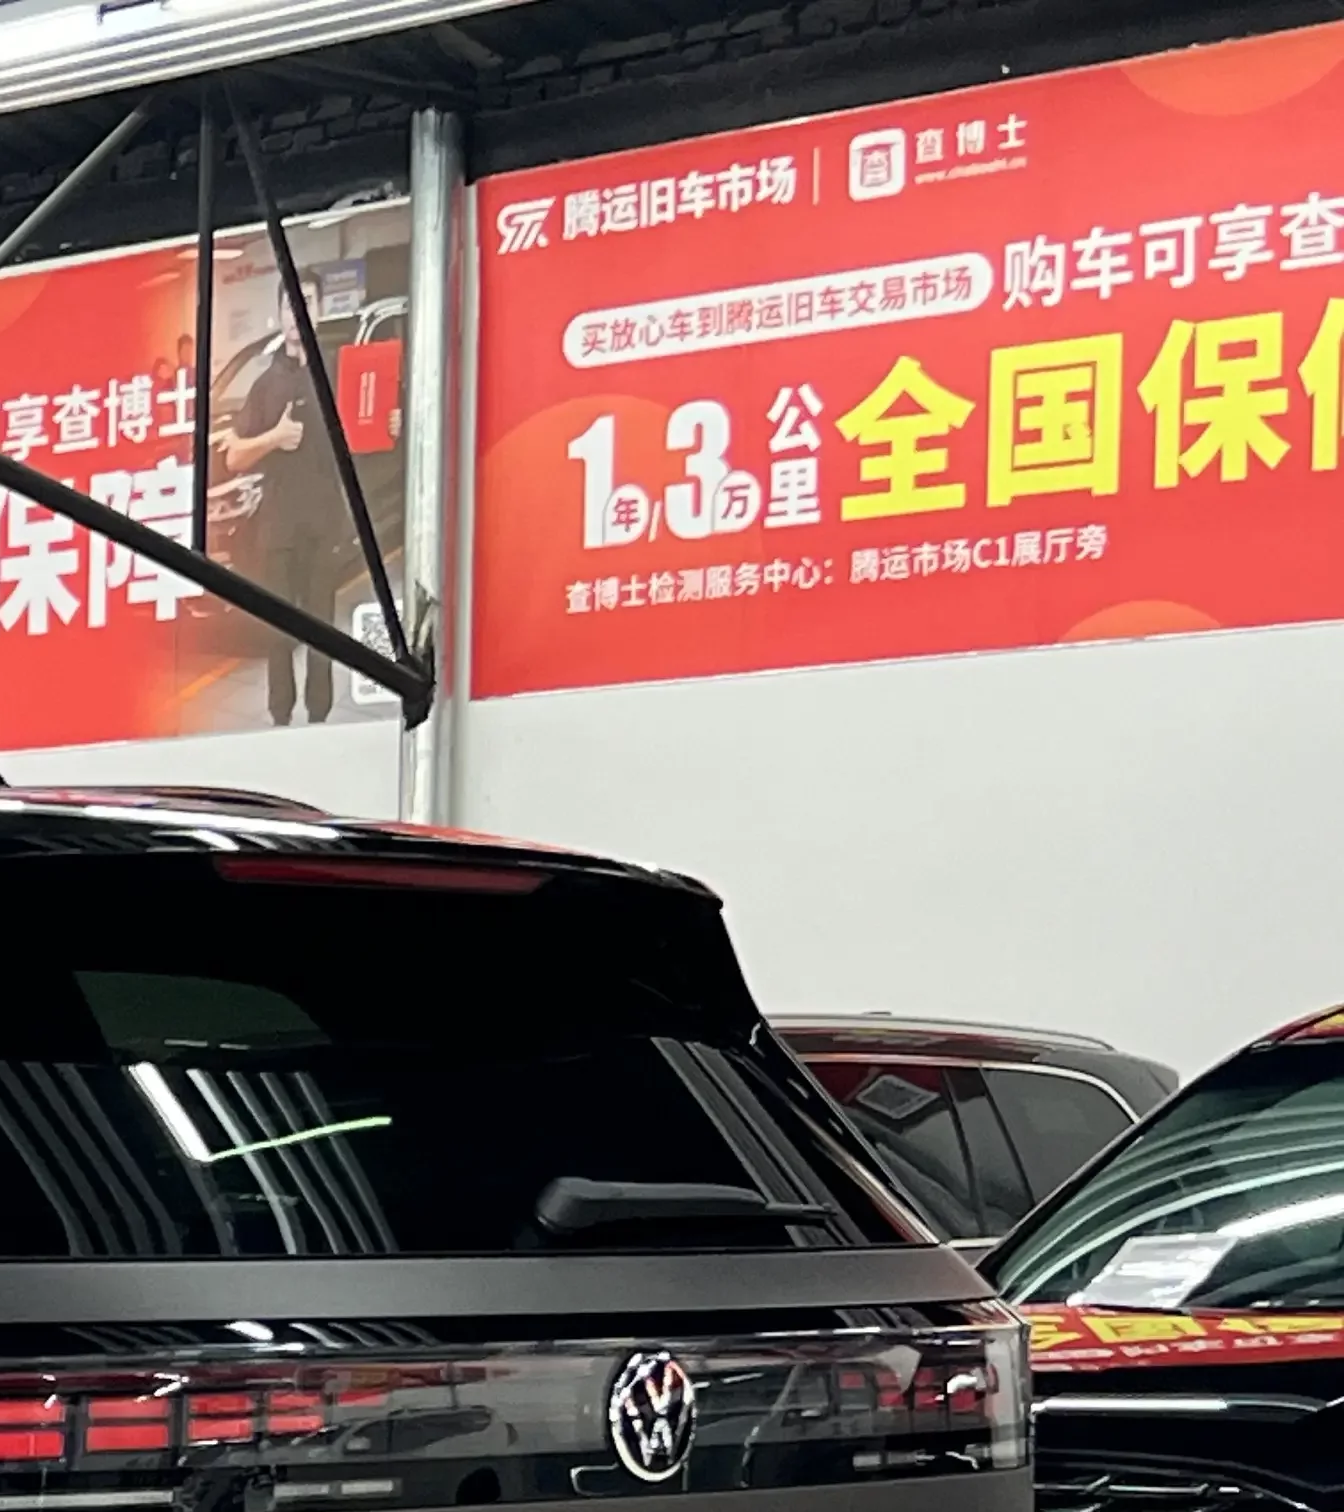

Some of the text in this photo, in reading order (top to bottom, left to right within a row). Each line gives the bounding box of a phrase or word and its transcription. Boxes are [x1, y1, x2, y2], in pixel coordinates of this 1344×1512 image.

[563, 156, 797, 241] 腾运旧车市场
[914, 113, 1028, 165] 查博士
[580, 266, 973, 358] 买放心车到腾运旧车交易市场
